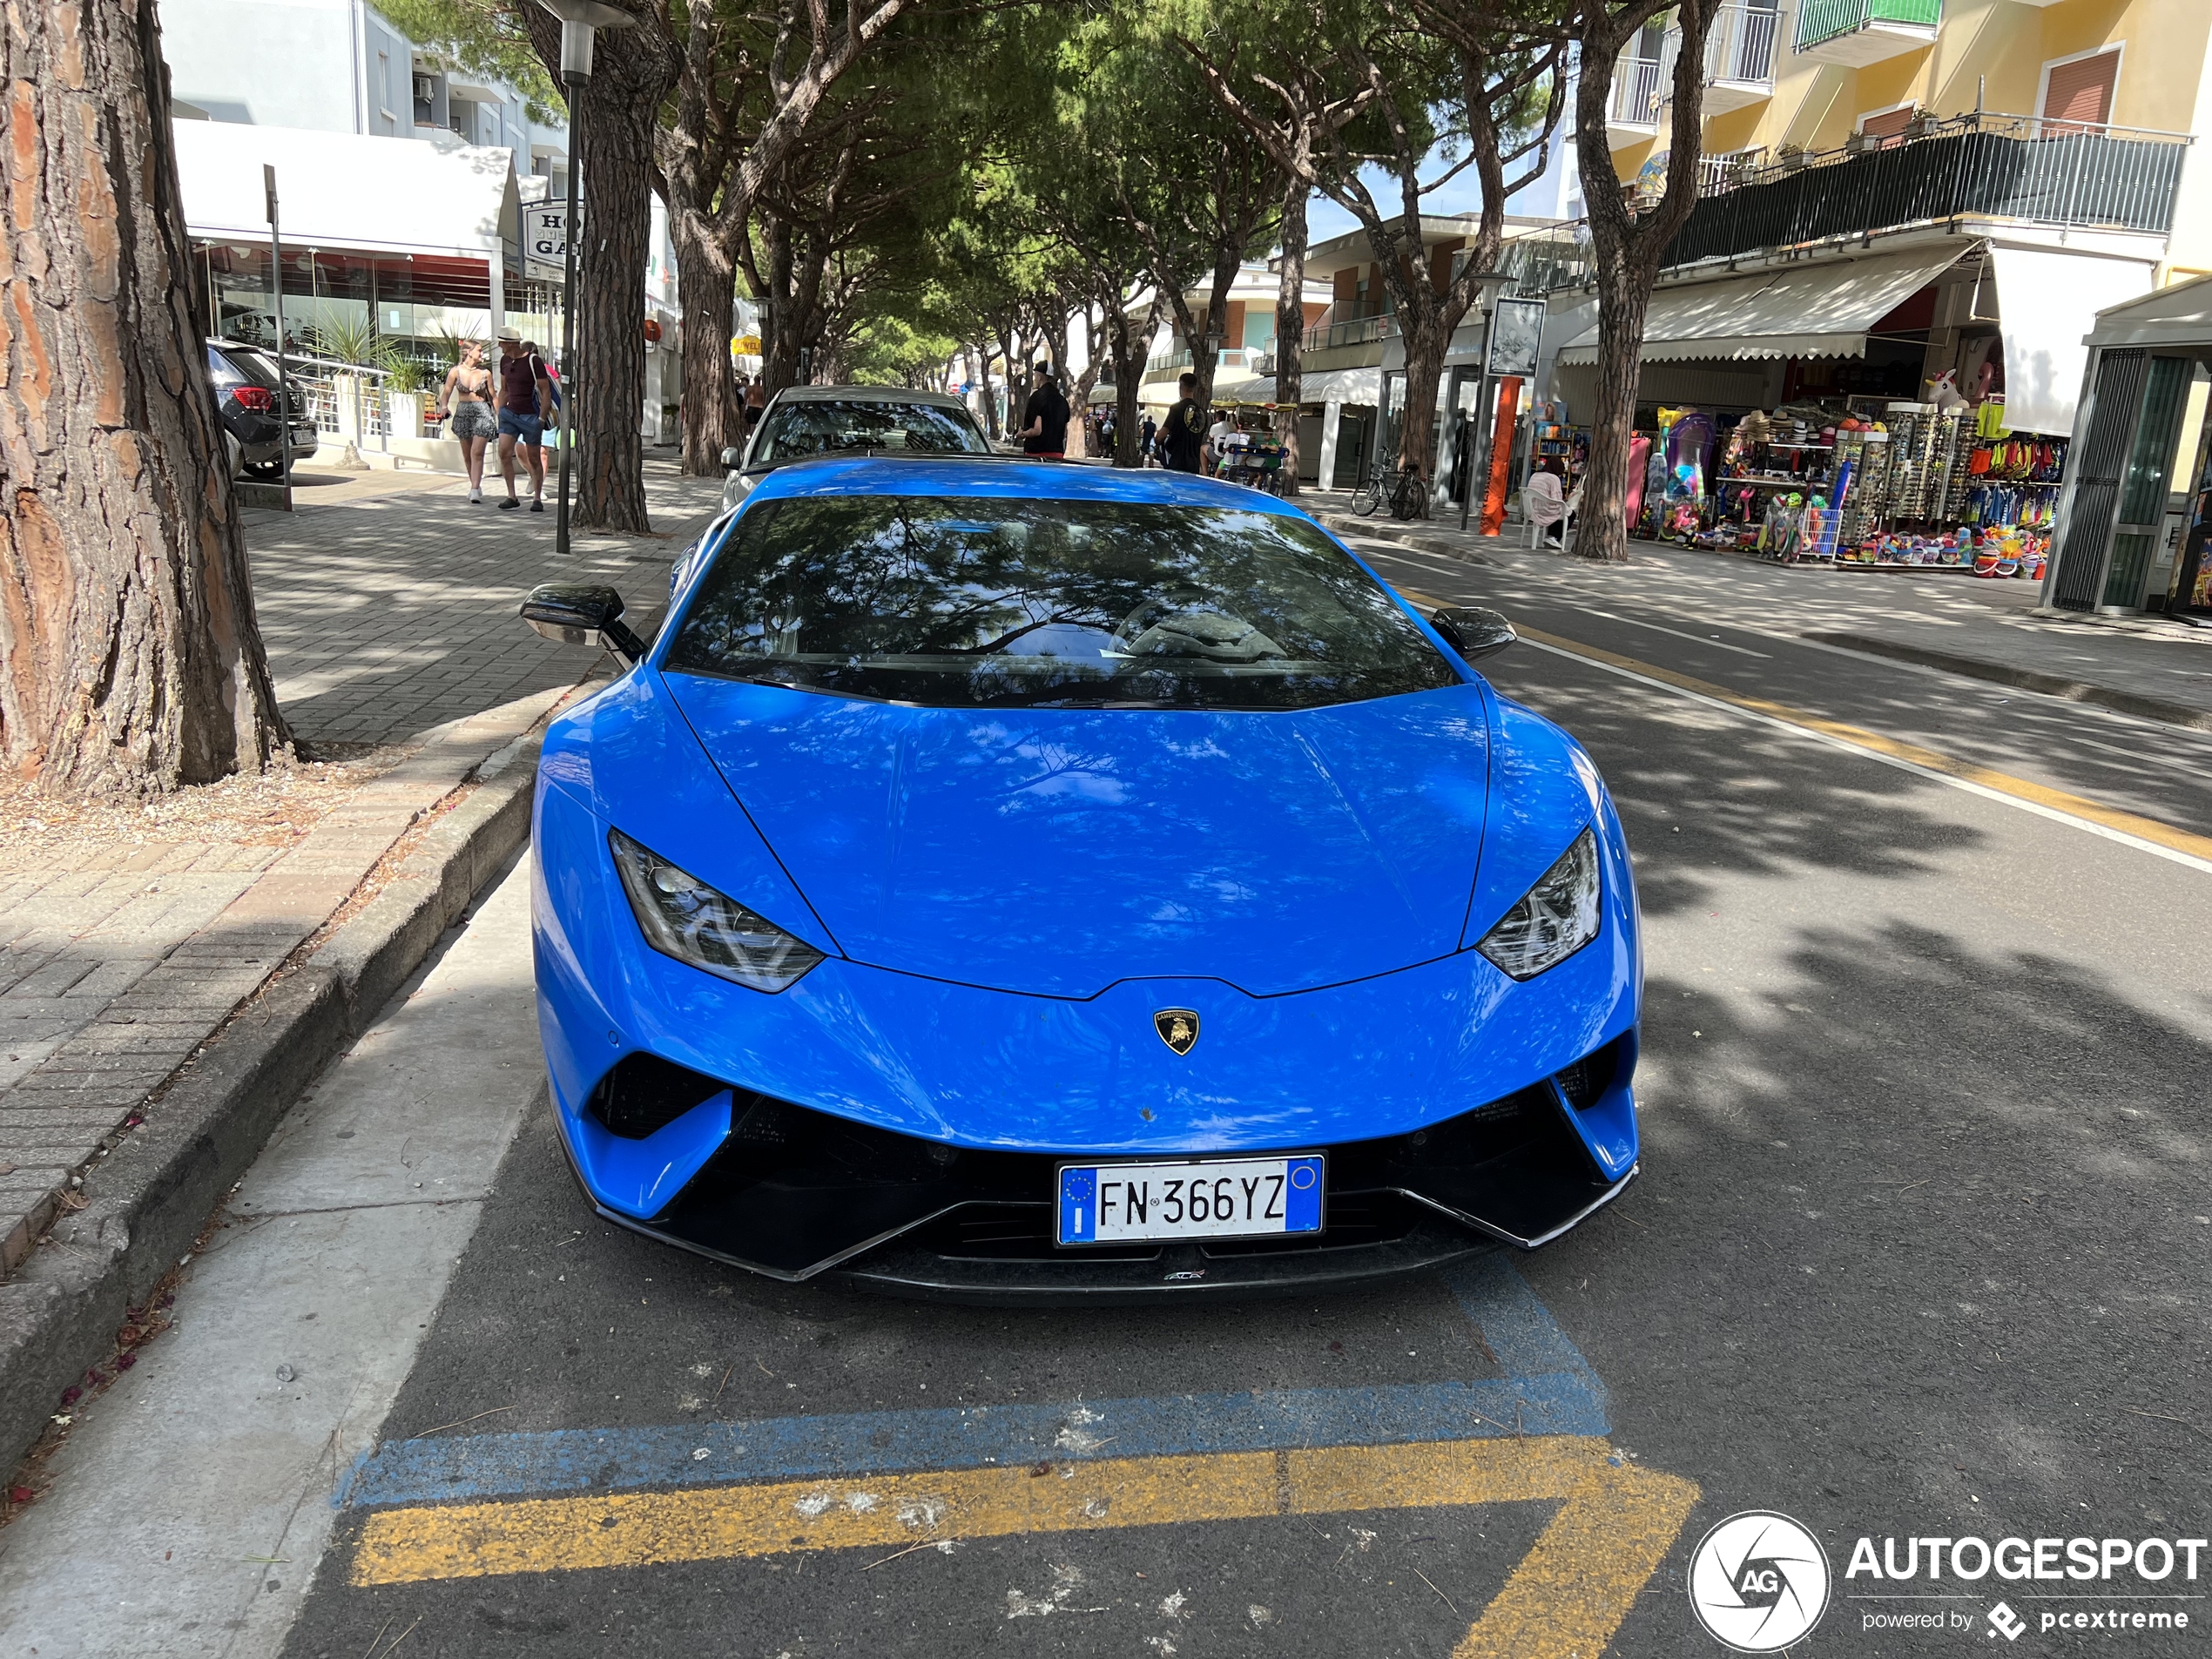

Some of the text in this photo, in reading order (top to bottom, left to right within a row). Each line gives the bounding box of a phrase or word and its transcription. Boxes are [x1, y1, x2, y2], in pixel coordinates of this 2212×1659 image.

[1157, 1011, 1196, 1021] LAMBORGHINI
[1100, 1175, 1285, 1225] FN 366YZ
